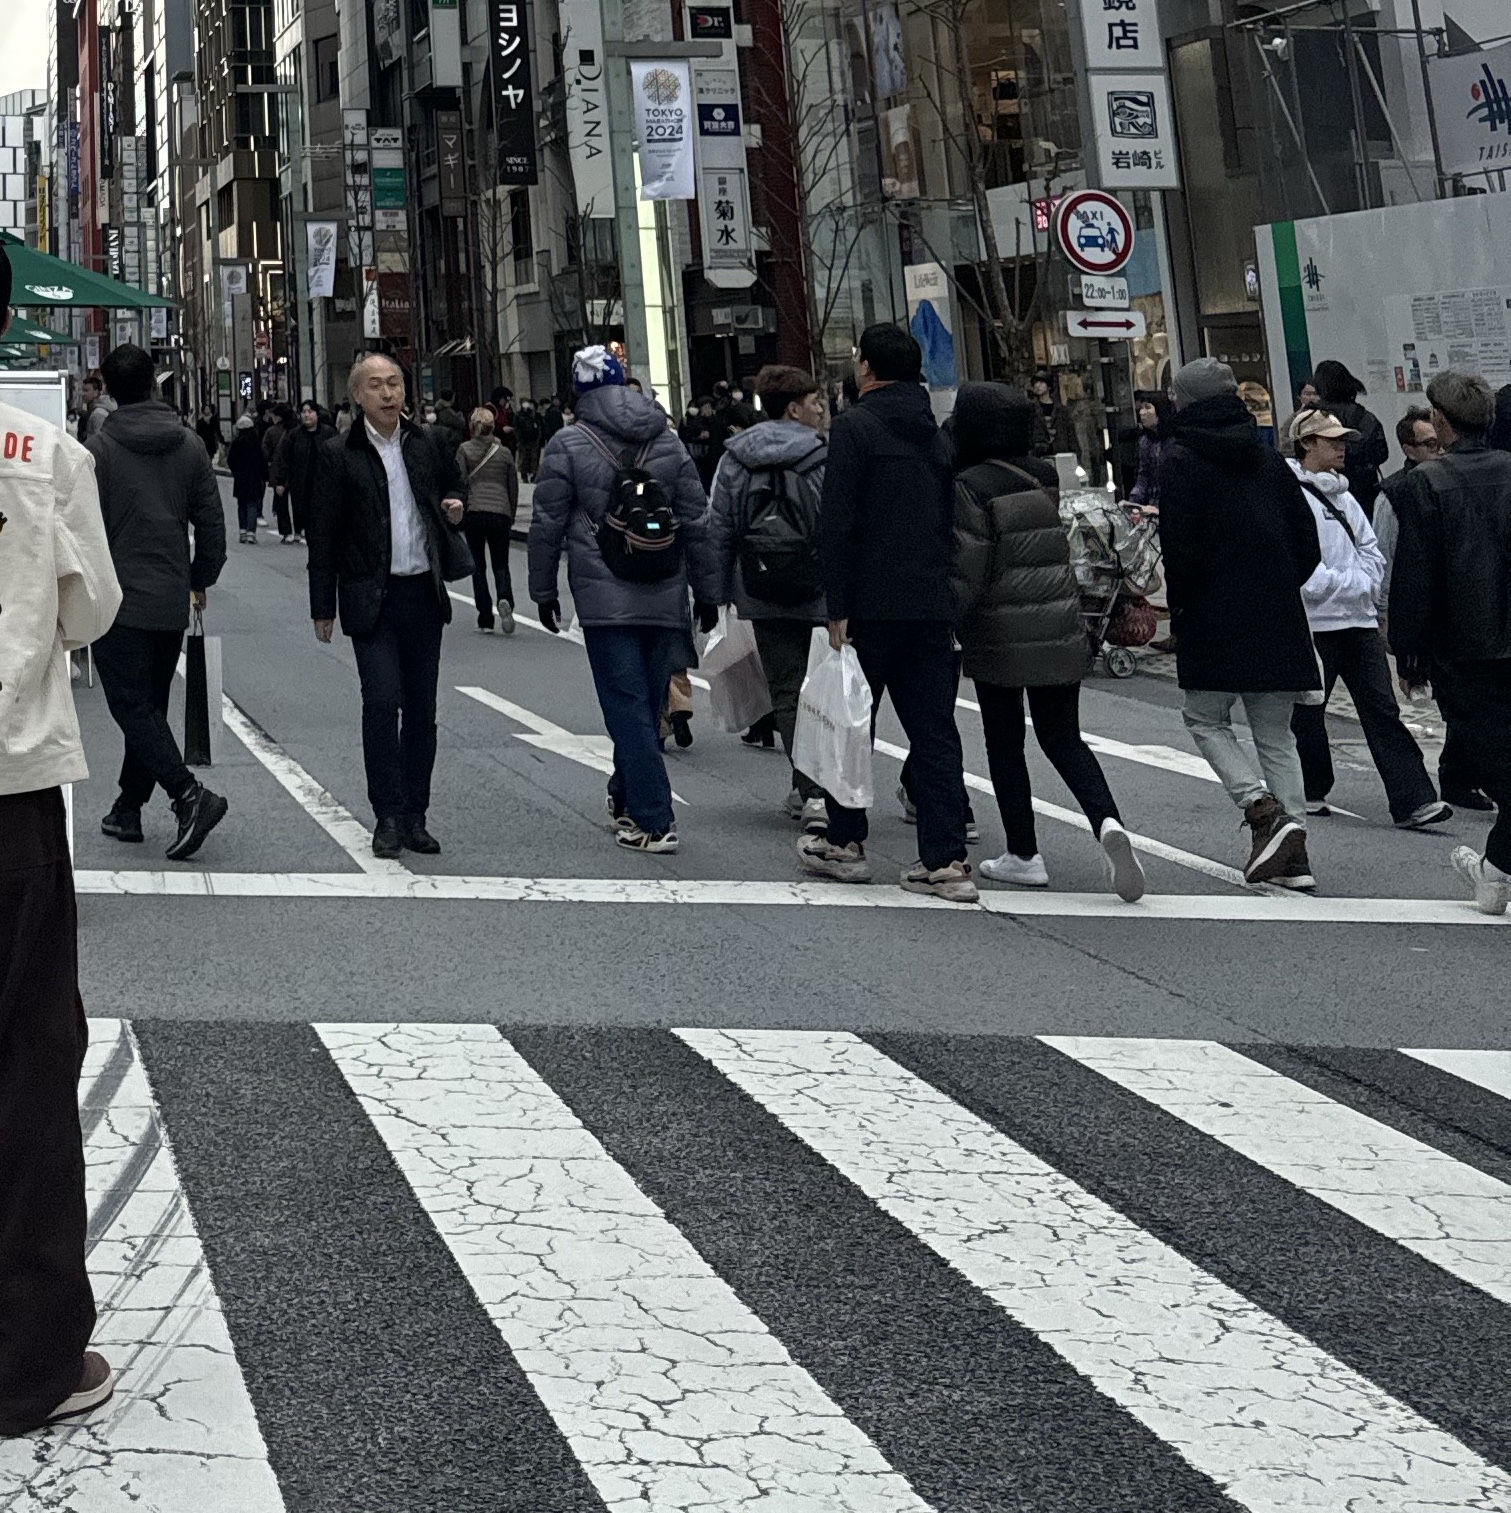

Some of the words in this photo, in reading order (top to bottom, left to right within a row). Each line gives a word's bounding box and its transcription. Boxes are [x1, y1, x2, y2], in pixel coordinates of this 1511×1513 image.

[498, 4, 525, 109] ヨシノヤ
[576, 49, 603, 160] DIANA
[645, 108, 683, 117] TOKYO
[646, 124, 683, 137] 2024
[1111, 148, 1164, 171] 岩崎ビル
[714, 199, 737, 245] 菊水
[1084, 283, 1127, 301] 22:00-1:00
